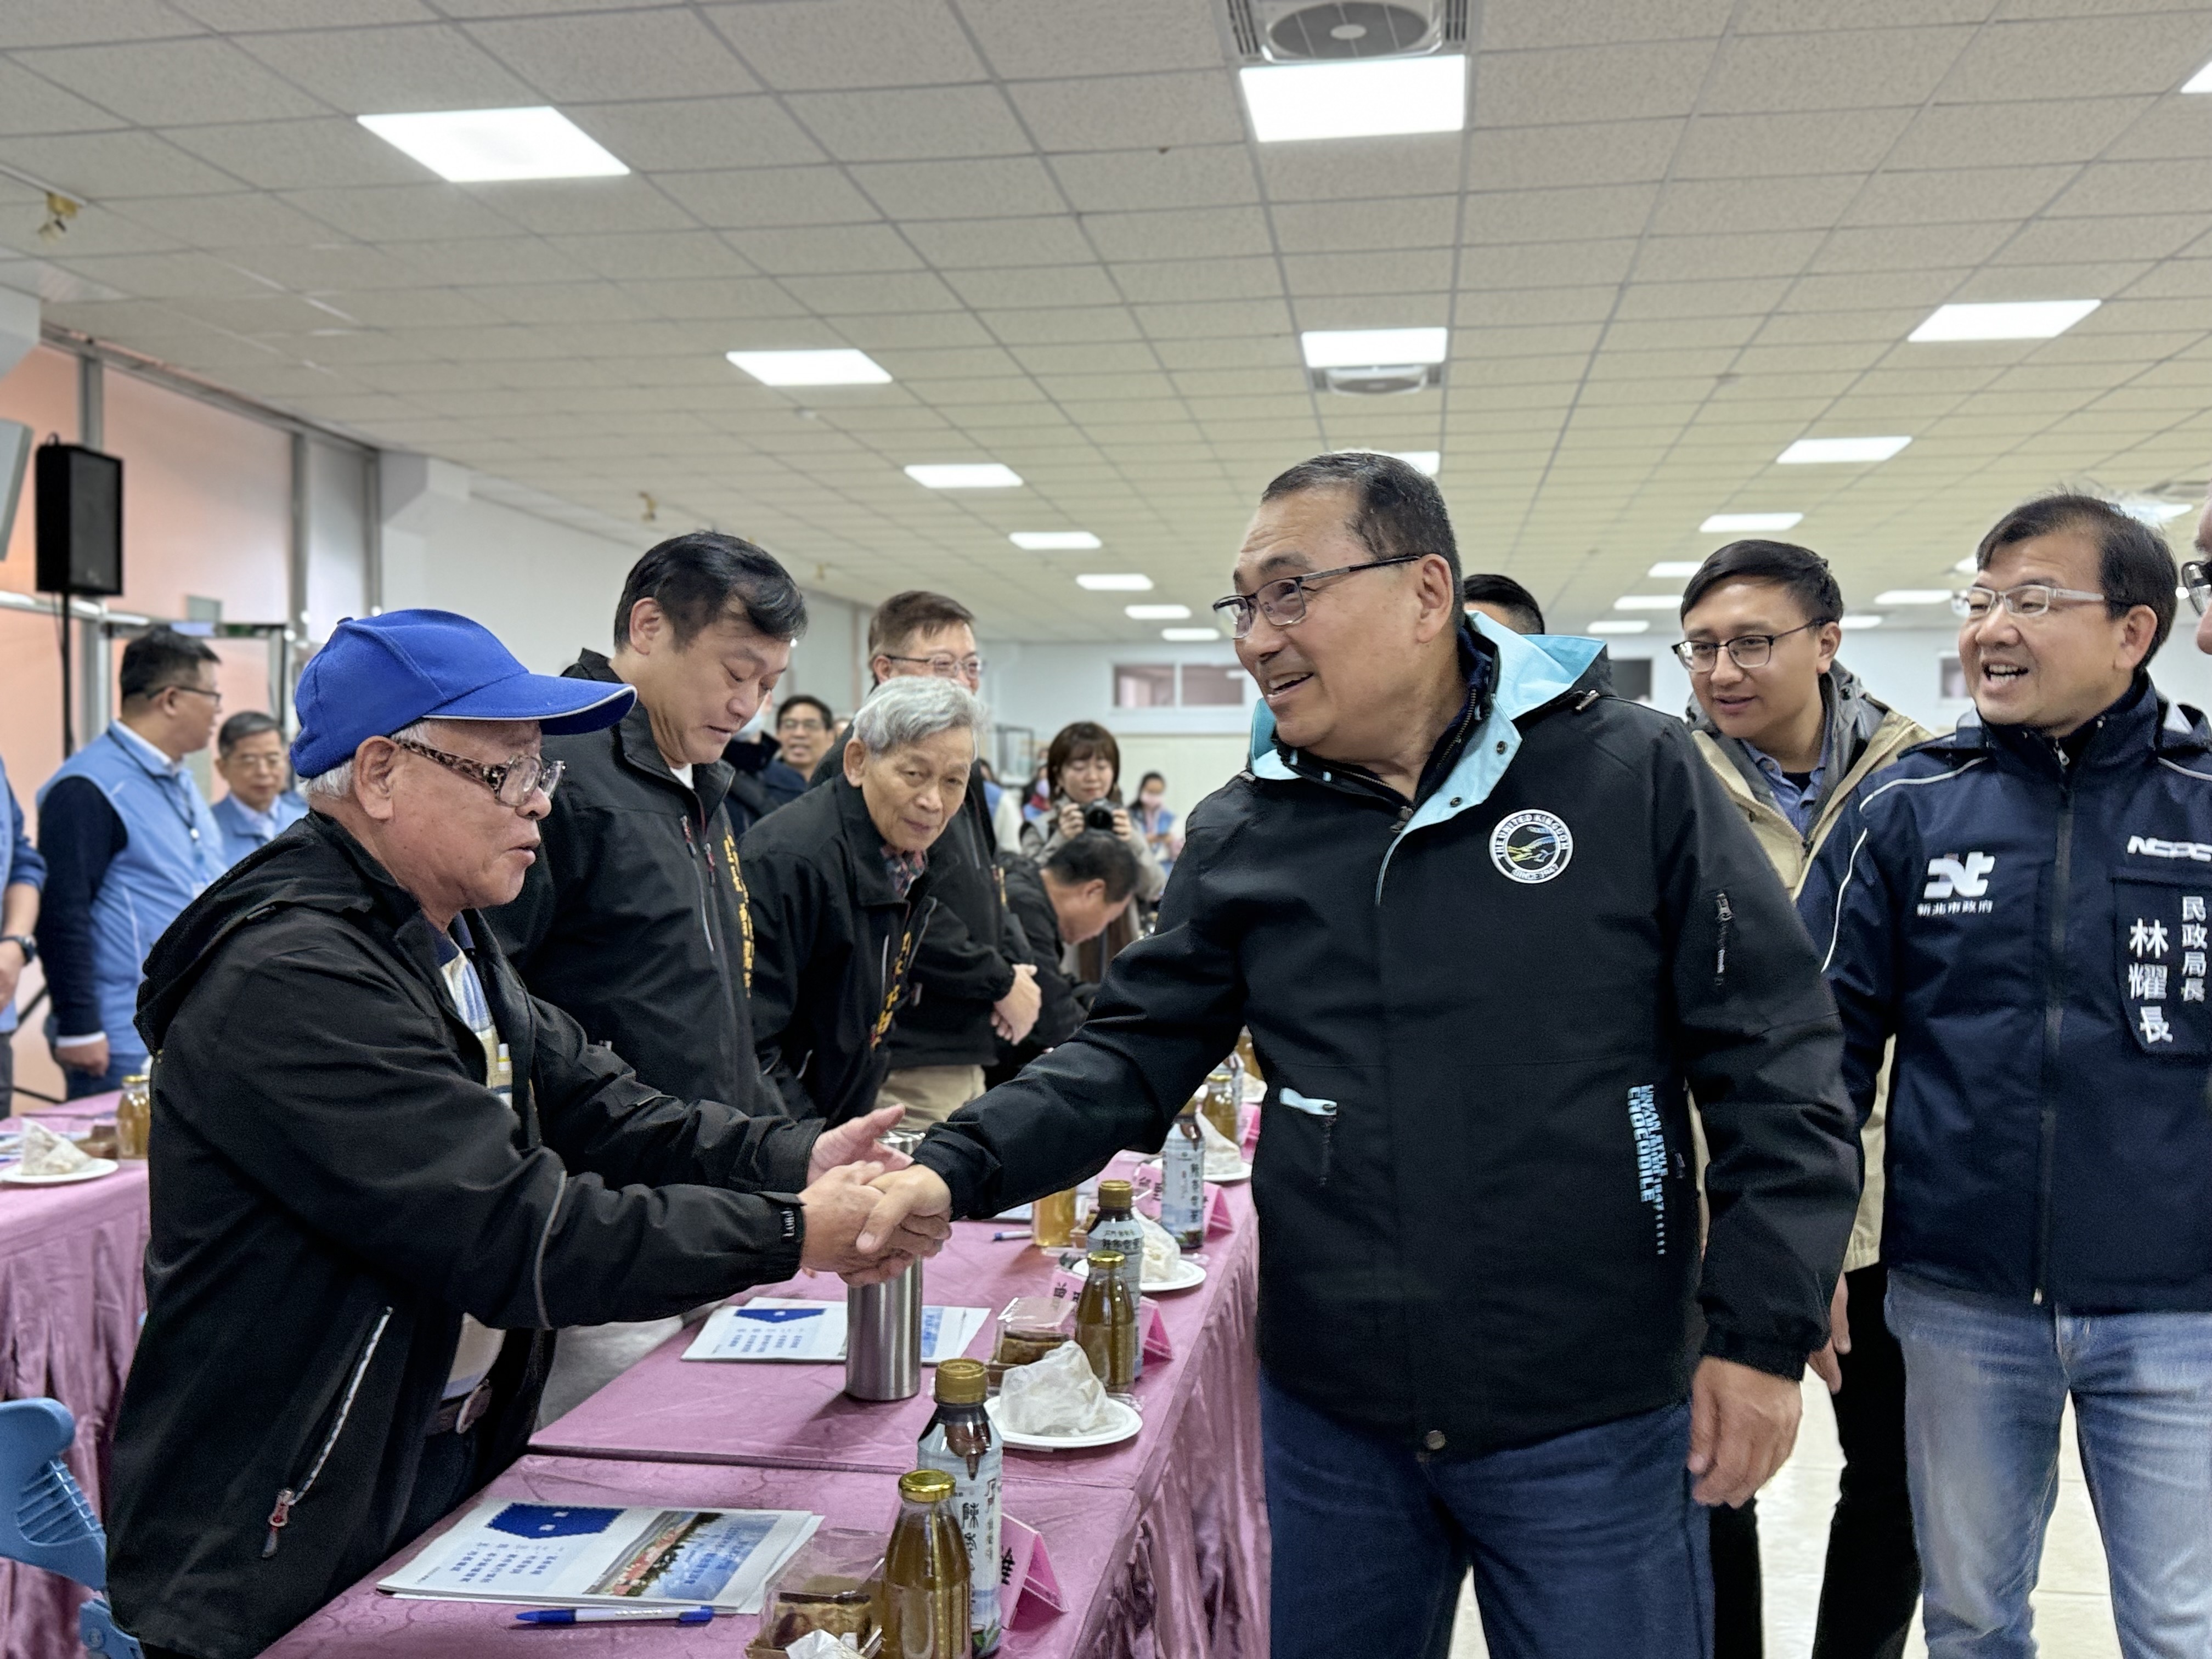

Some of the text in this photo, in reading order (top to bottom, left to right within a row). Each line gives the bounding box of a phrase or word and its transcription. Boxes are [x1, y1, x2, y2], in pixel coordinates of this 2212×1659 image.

[1498, 814, 1533, 839] UNITED
[1533, 814, 1570, 850] KINGDOM
[1917, 900, 1994, 917] 新北市政府
[2181, 895, 2208, 1003] 民政局長
[2129, 918, 2173, 1043] 林耀長
[1627, 1086, 1655, 1203] CROCODILE
